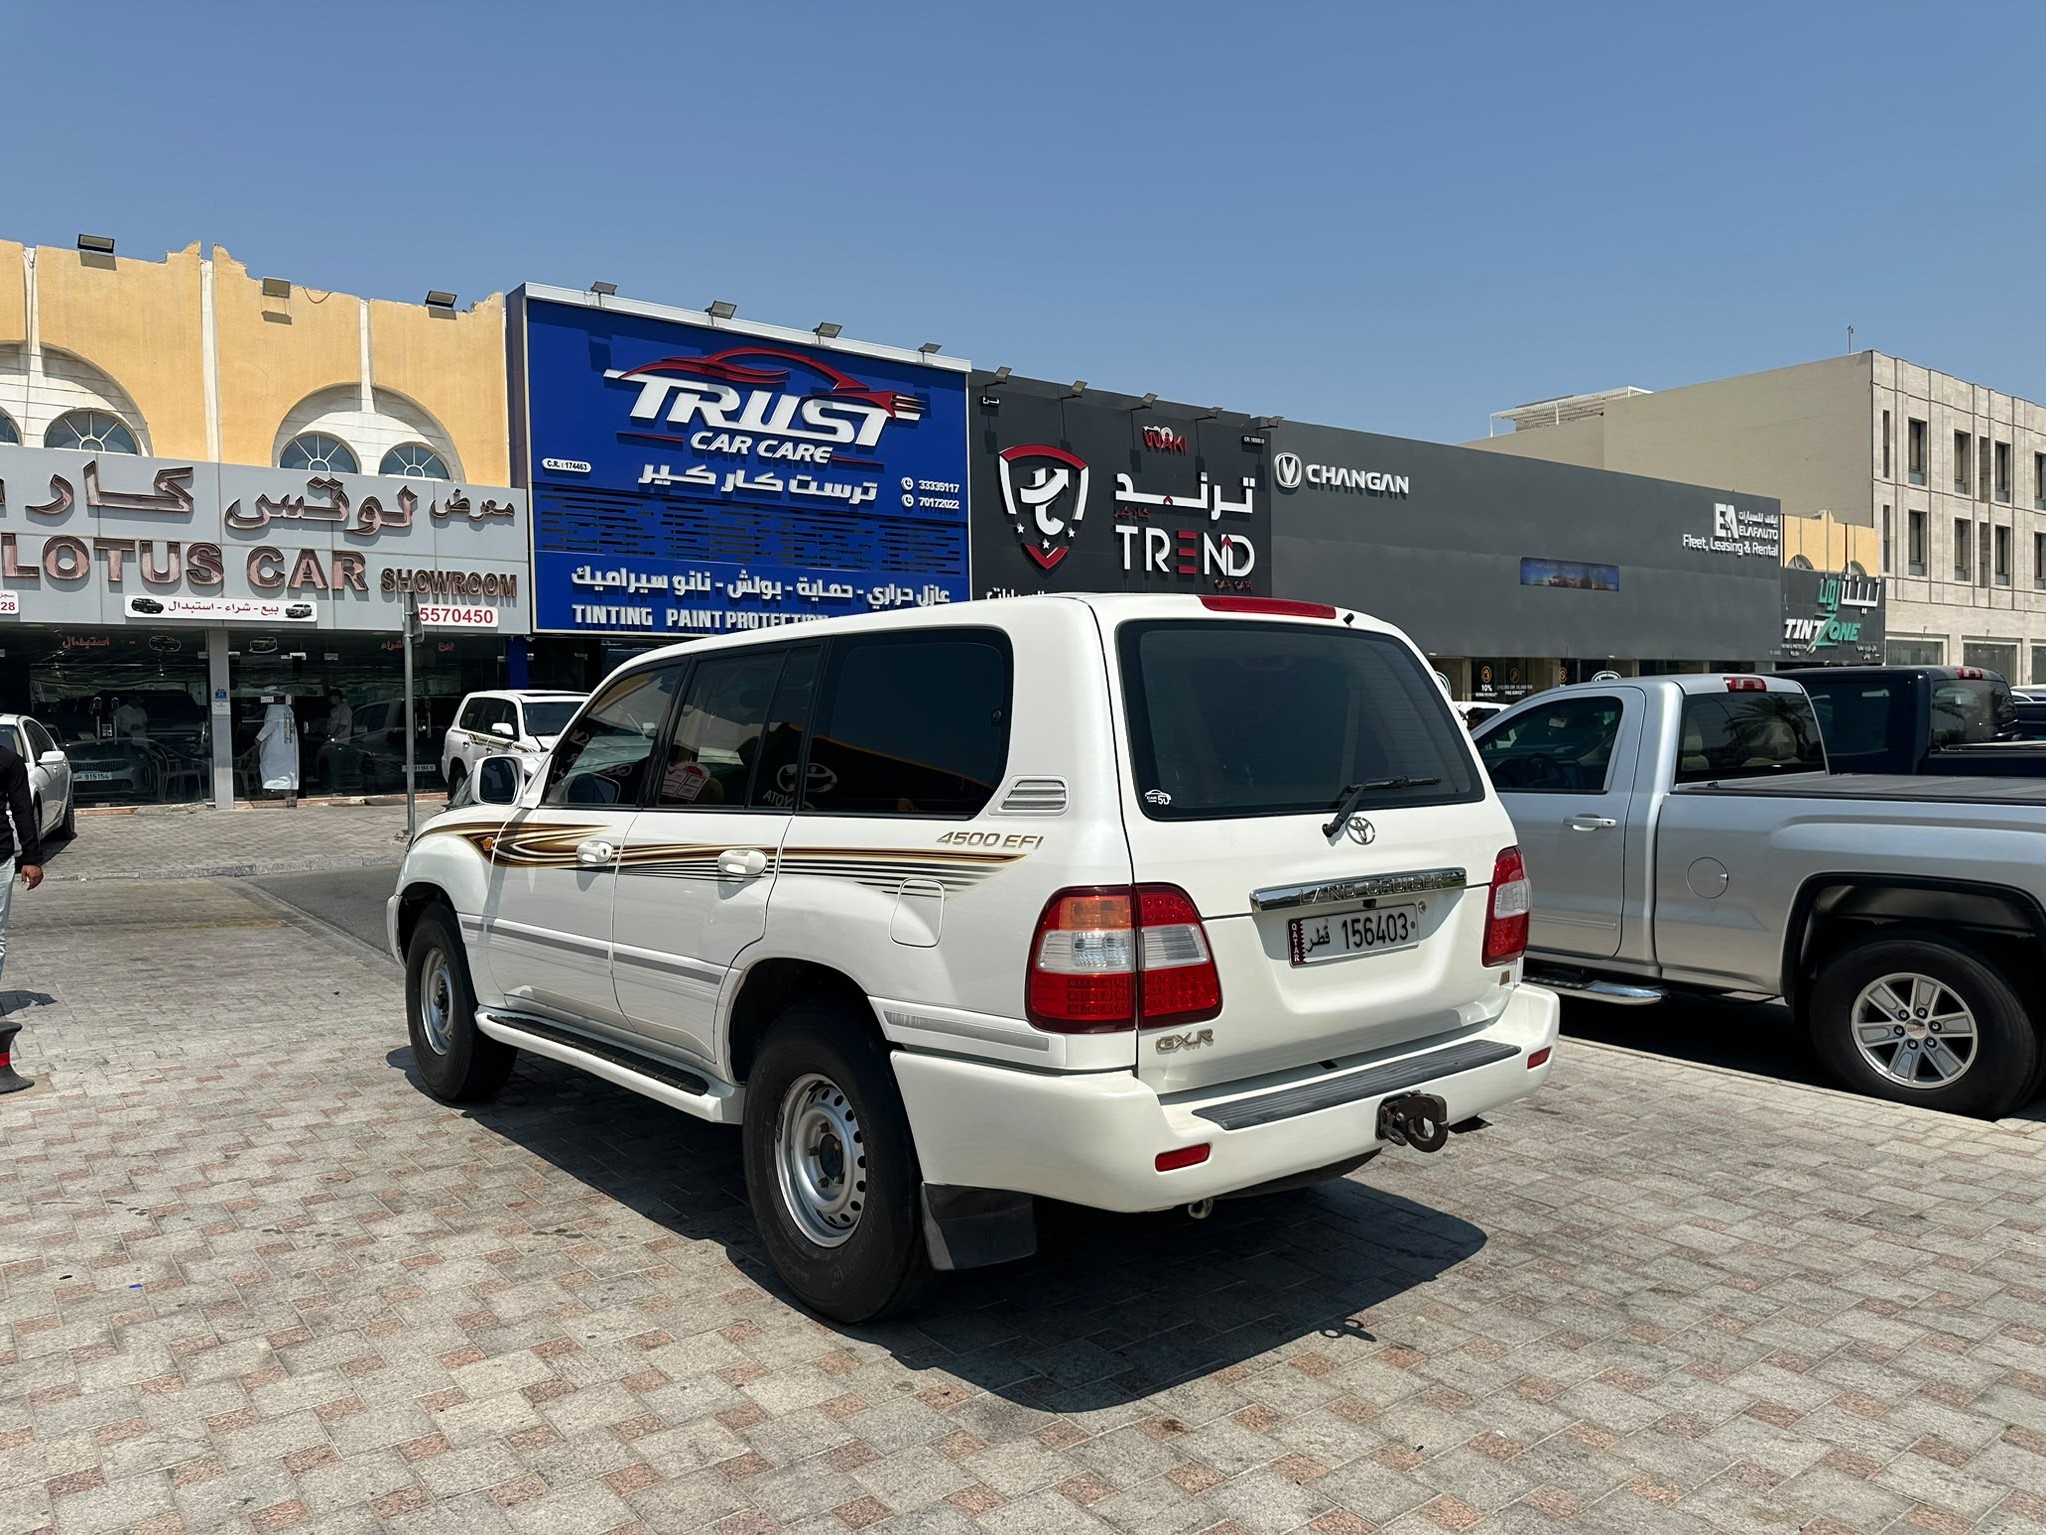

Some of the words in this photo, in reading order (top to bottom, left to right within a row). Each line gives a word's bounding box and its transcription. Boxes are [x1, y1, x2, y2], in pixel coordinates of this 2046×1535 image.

[603, 369, 920, 446] TRUST
[690, 431, 752, 455] CAR
[757, 439, 833, 464] CARE
[25, 460, 194, 514] كار
[638, 464, 717, 485] كير
[721, 469, 783, 492] كار
[788, 474, 878, 504] ترست
[1306, 464, 1409, 494] CHANGAN
[225, 476, 418, 535] لوتس
[429, 488, 516, 521] معرض
[1115, 472, 1256, 520] ترند
[1115, 525, 1255, 577] TREND
[1683, 534, 1709, 551] Fleet,
[1710, 537, 1743, 555] Leasing
[1752, 542, 1779, 556] Rental
[1, 533, 224, 585] LOTUS
[247, 545, 369, 591] CAR
[380, 568, 517, 598] SHOWROOM
[571, 565, 668, 593] سيراميك
[672, 570, 711, 596] نانو
[727, 569, 782, 600] بولش
[796, 576, 853, 601] حماية
[867, 584, 914, 609] حراري
[916, 584, 950, 606] عازل
[168, 600, 214, 613] استبدال
[225, 601, 251, 613] شراء
[261, 604, 279, 616] بيع
[572, 604, 653, 626] TINTING
[666, 608, 723, 628] PAINT
[1785, 618, 1825, 639] TINT
[936, 832, 1000, 846] 4500
[1002, 834, 1044, 849] EFI
[1299, 883, 1356, 904] LAND
[1366, 873, 1444, 896] CRUISER
[1291, 922, 1300, 962] QATAR
[1342, 912, 1408, 949] 156403
